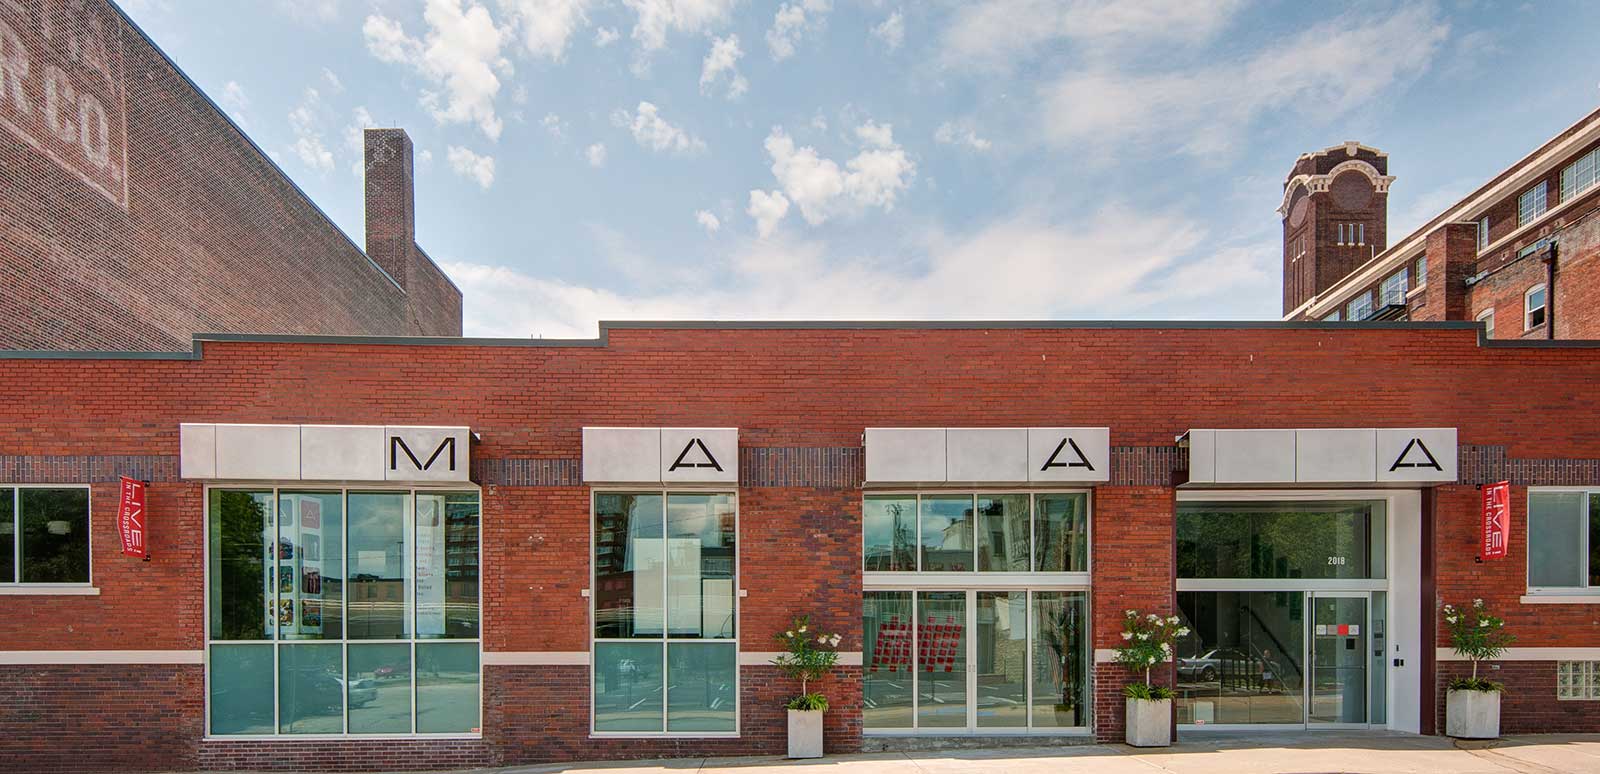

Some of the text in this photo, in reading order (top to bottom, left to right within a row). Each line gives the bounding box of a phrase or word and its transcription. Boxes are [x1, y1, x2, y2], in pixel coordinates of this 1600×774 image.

[390, 437, 456, 471] M
[668, 438, 724, 472] A
[1040, 438, 1096, 472] A
[1389, 438, 1444, 472] A
[126, 481, 131, 489] IN
[123, 507, 132, 552] CROSSROADS
[131, 483, 142, 554] LIVE!
[1492, 486, 1503, 554] LIVE!
[1327, 556, 1345, 565] 2018
